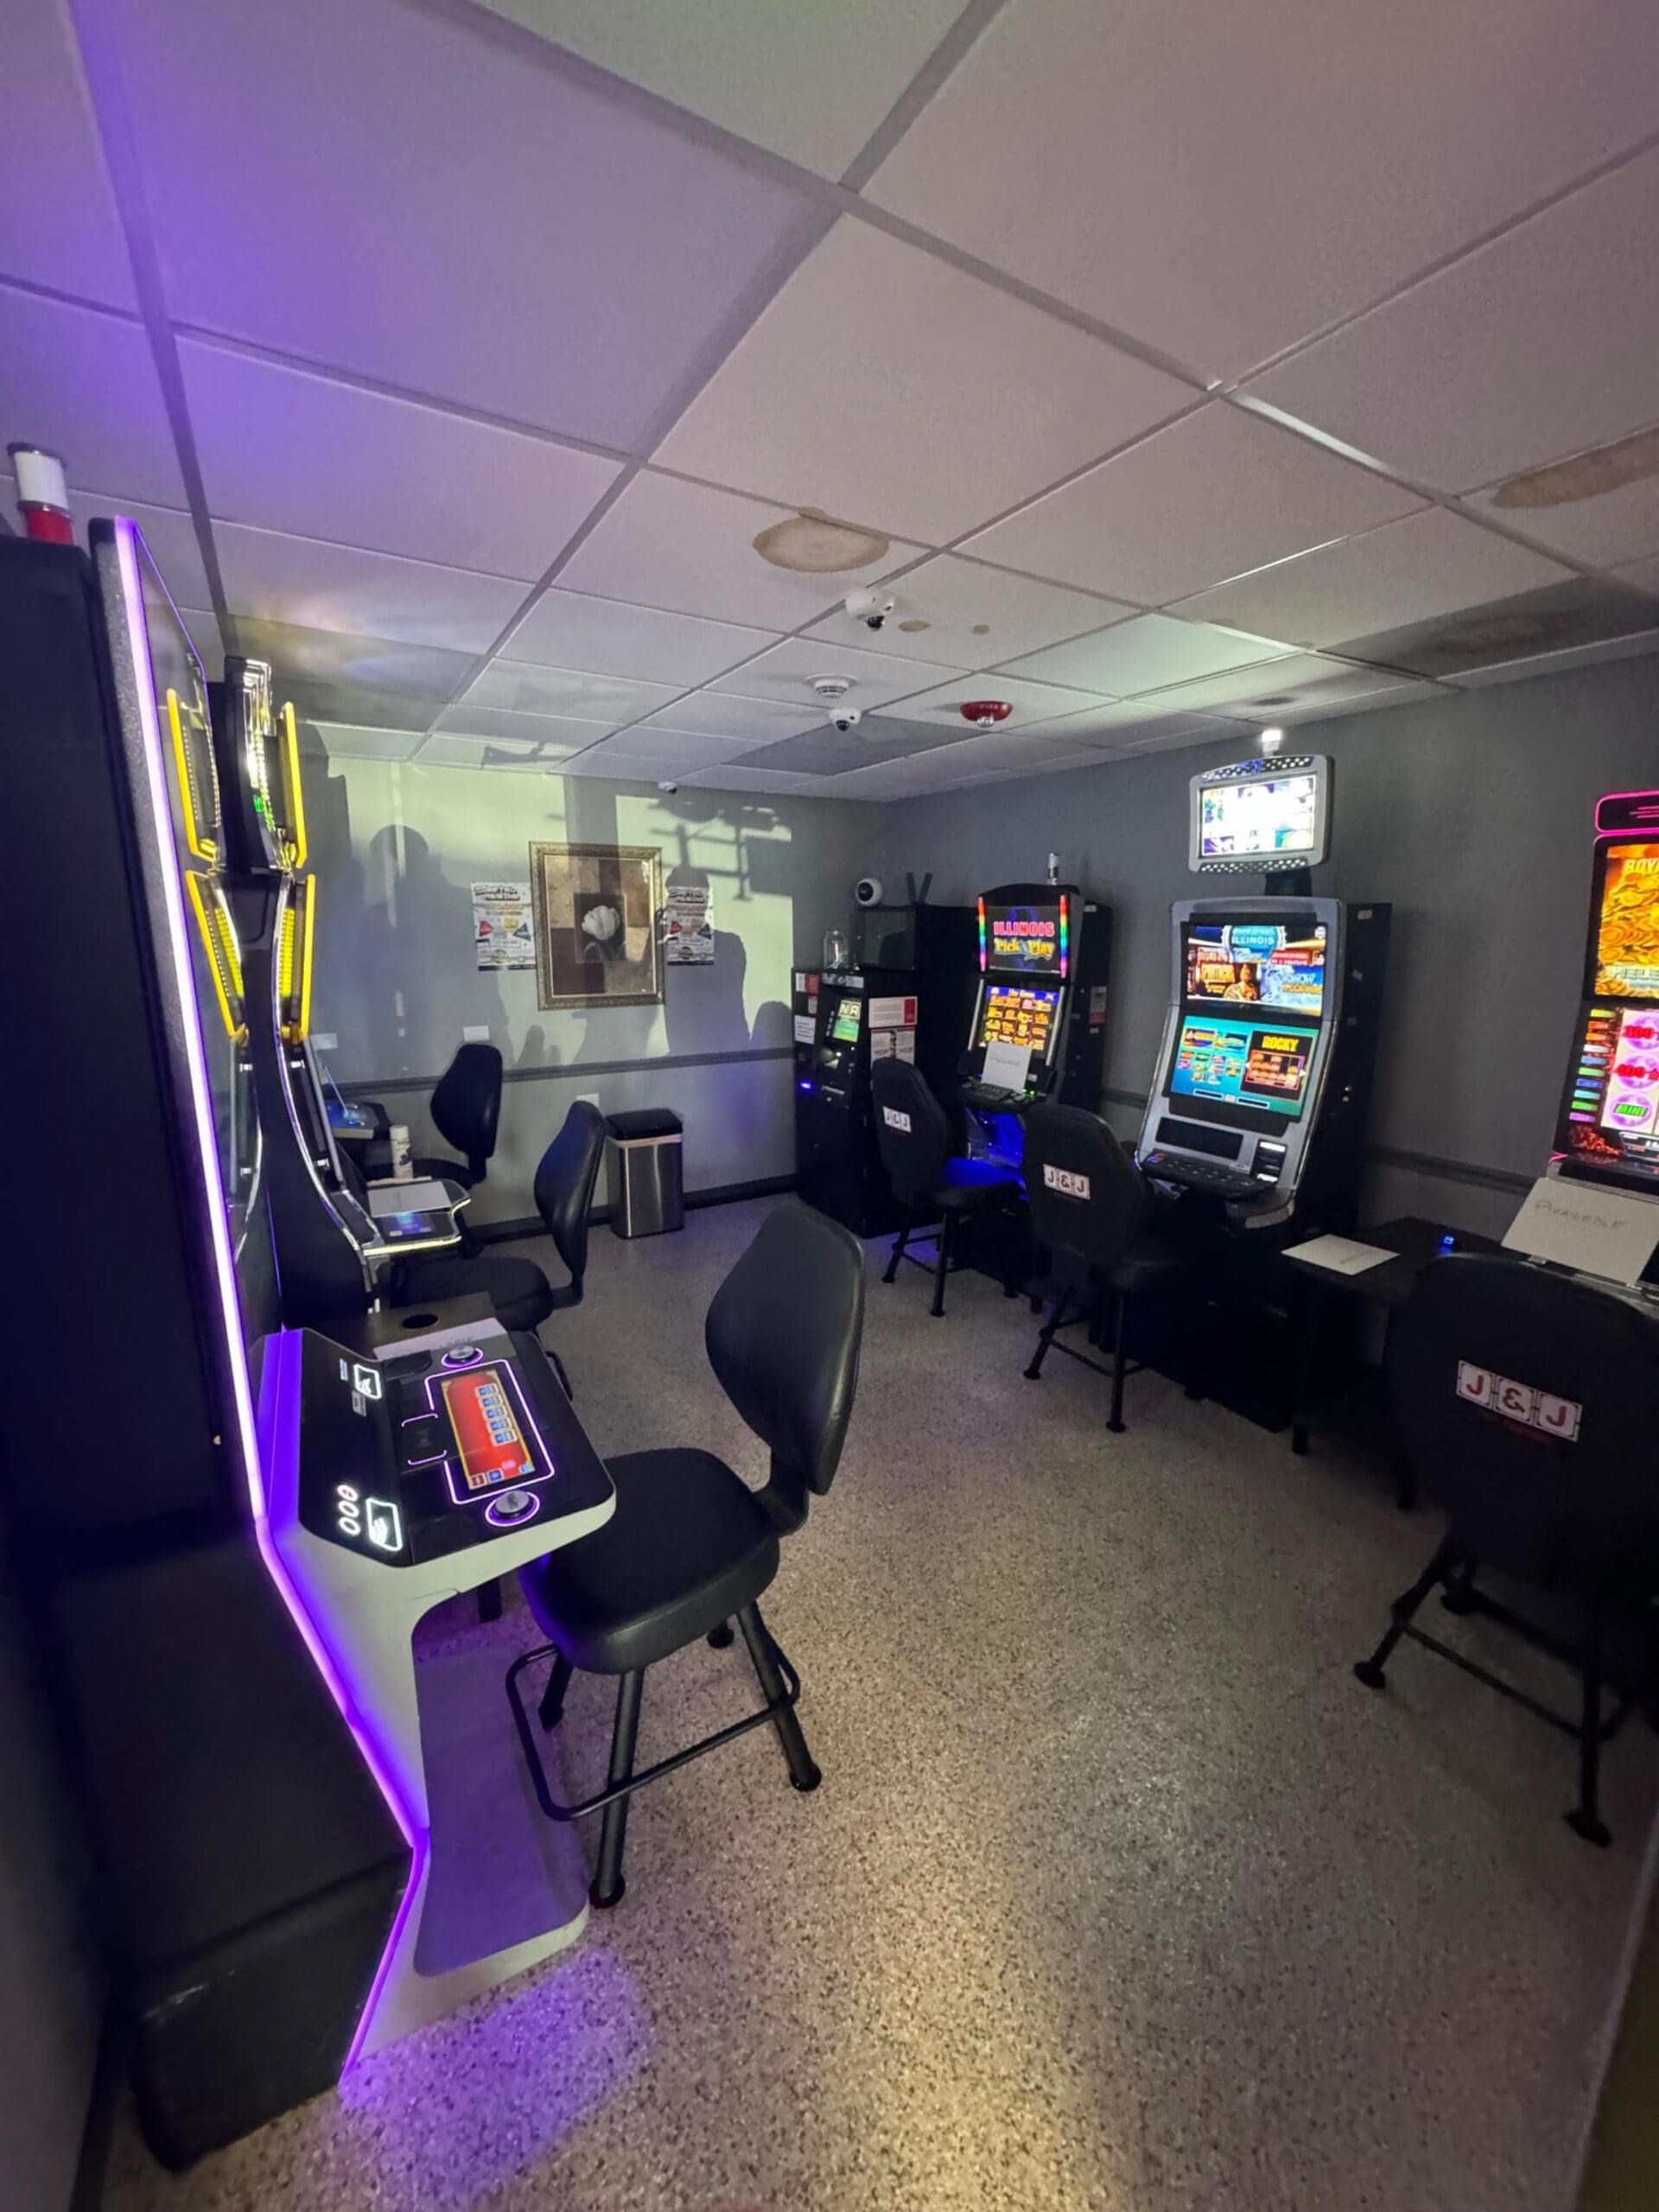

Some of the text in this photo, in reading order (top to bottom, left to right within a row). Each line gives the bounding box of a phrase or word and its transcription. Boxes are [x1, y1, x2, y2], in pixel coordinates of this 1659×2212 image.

[993, 921, 1055, 938] ILLINOIS
[994, 938, 1020, 954] Pick
[1027, 938, 1056, 960] Play
[1230, 936, 1275, 946] ILLINOIS
[1262, 1035, 1300, 1052] ROCKY
[1616, 1103, 1646, 1117] MINI
[1047, 1169, 1085, 1193] J&J
[1465, 1374, 1568, 1427] J&J
